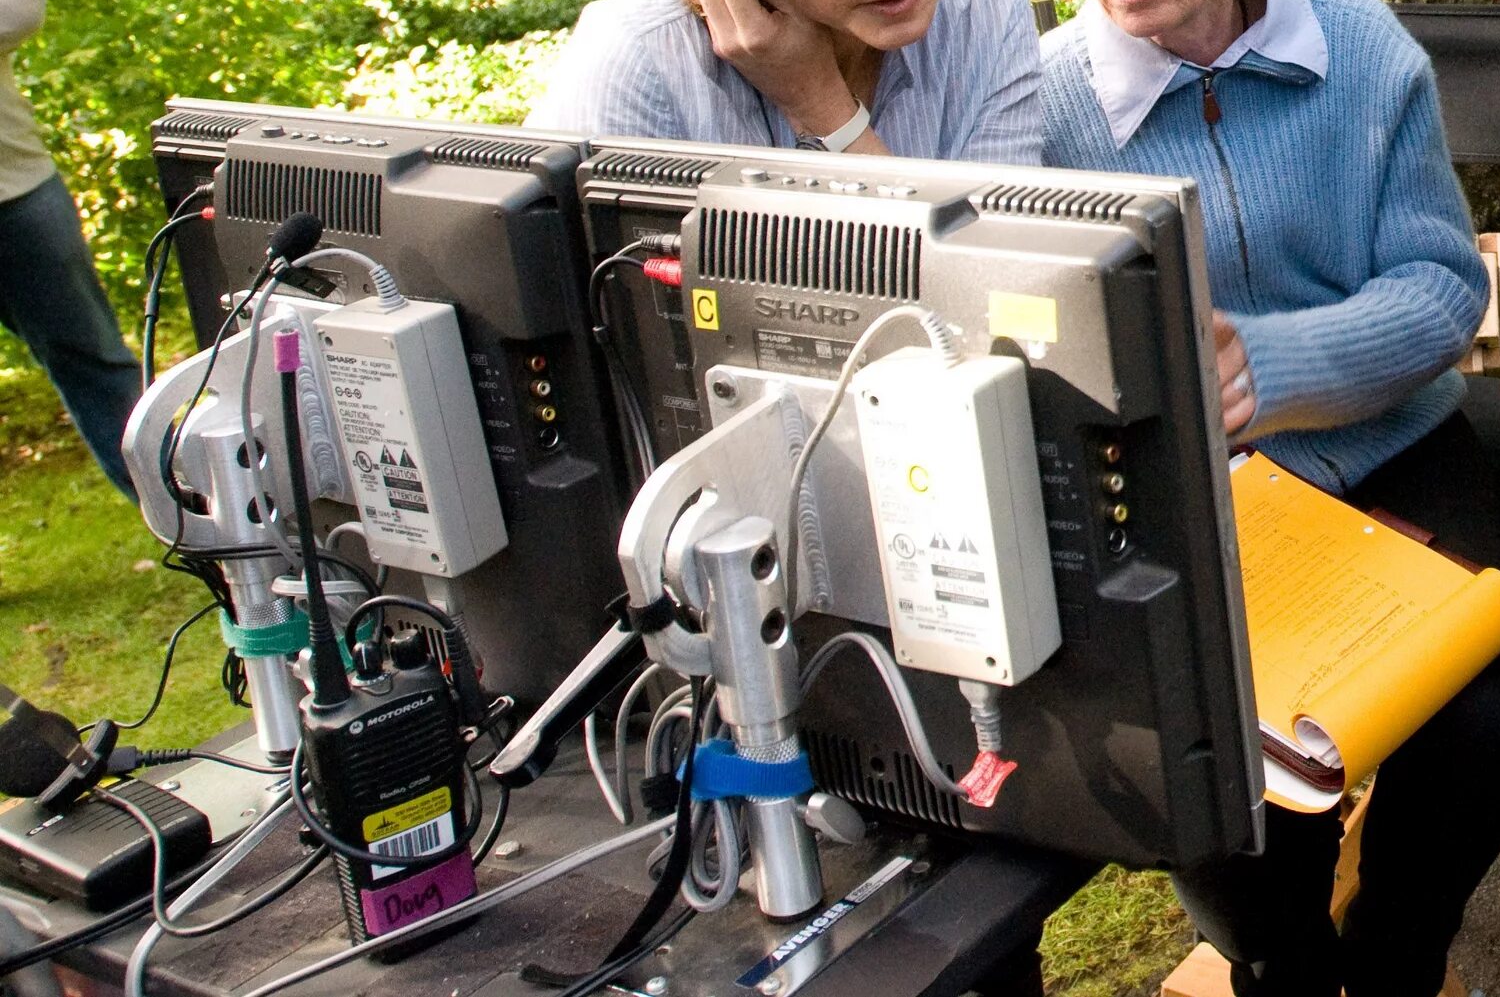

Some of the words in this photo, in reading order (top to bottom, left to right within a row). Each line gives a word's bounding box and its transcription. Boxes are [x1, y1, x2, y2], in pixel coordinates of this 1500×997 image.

[697, 296, 714, 322] C
[755, 297, 859, 326] SHARP
[758, 333, 791, 343] SHARP
[326, 354, 357, 364] SHARP
[384, 467, 417, 480] CAUTION
[909, 466, 928, 492] C
[388, 490, 424, 503] ATTENTION
[367, 694, 434, 726] MOTOROLA
[384, 883, 444, 924] Doug
[772, 903, 850, 961] AVENGER
